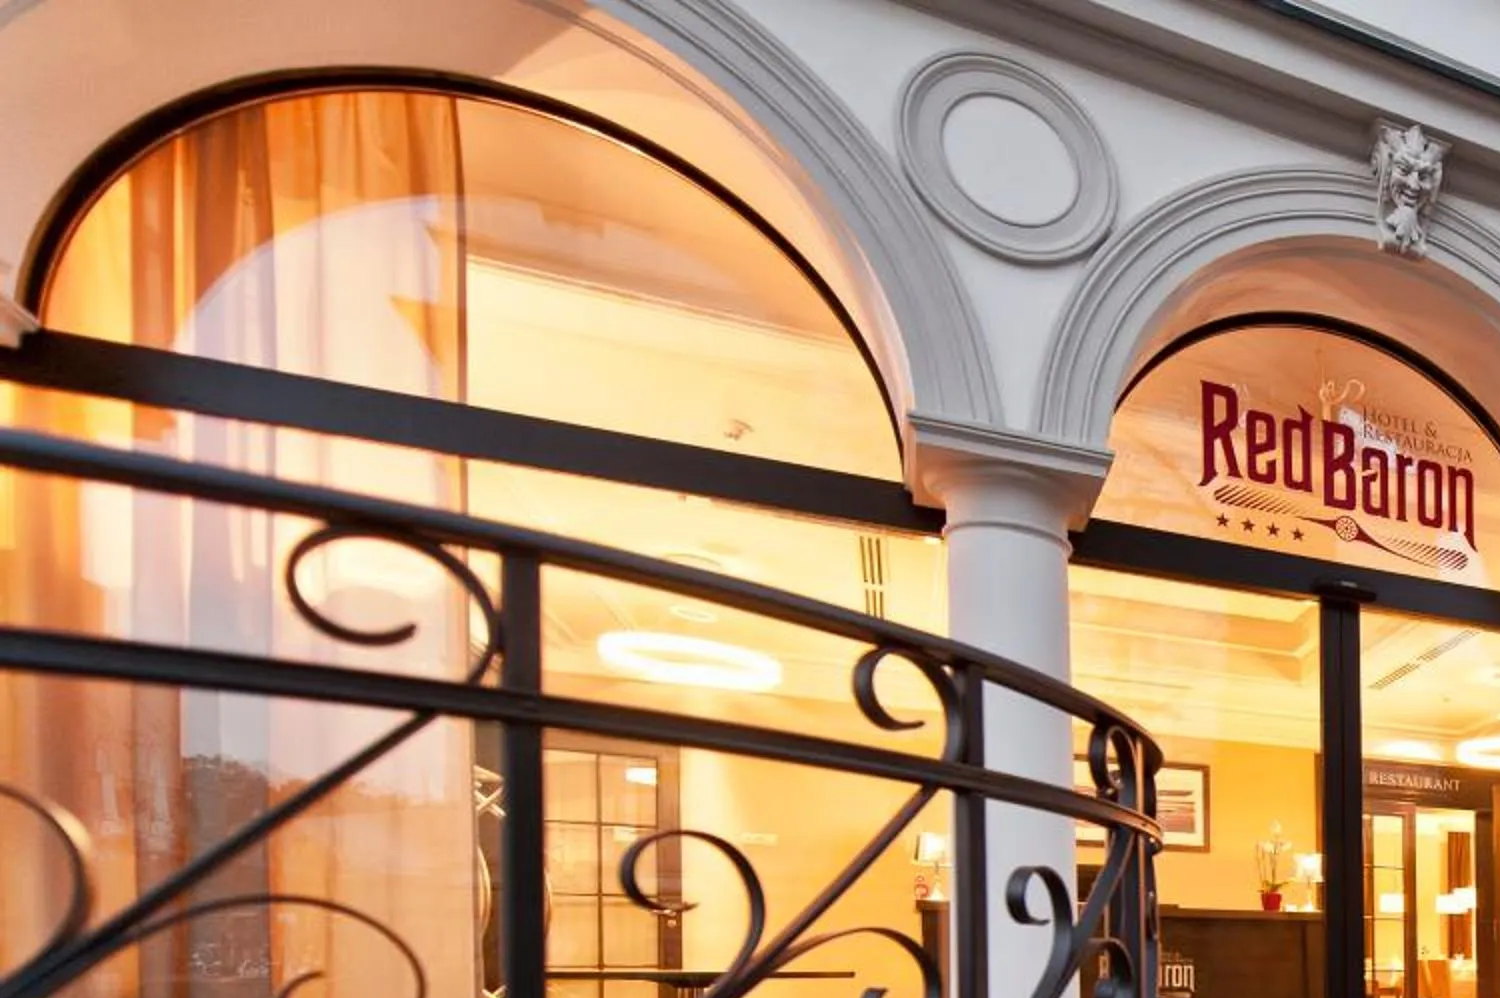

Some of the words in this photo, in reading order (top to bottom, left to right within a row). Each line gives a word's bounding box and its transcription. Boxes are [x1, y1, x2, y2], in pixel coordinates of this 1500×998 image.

[1362, 405, 1417, 434] HOTEL
[1424, 420, 1438, 439] &
[1362, 423, 1473, 463] RESTAURACJA
[1368, 770, 1461, 792] RESTAURANT
